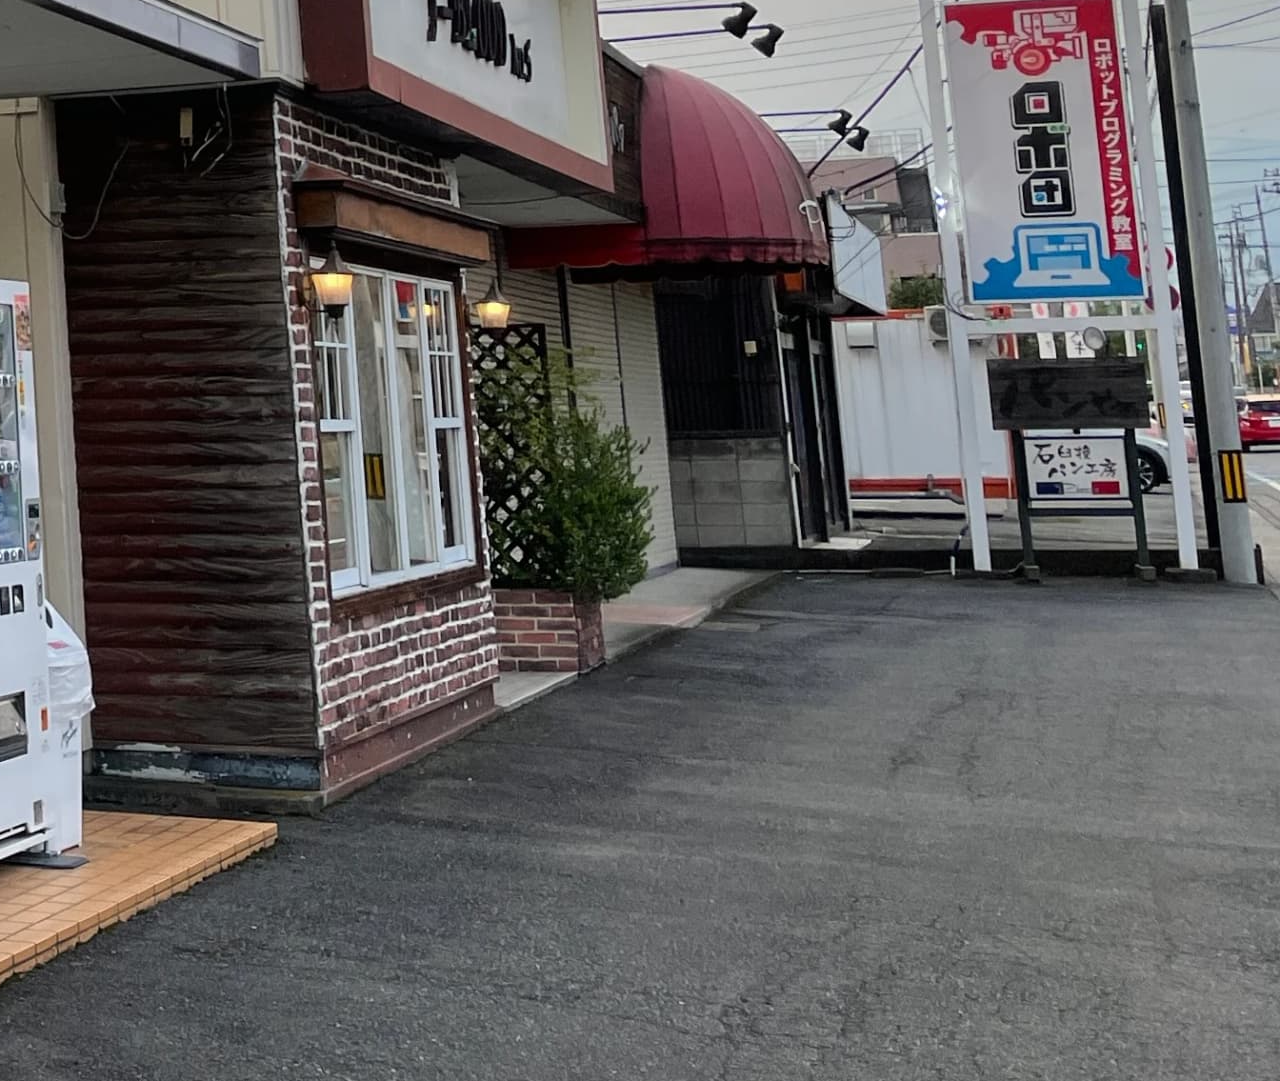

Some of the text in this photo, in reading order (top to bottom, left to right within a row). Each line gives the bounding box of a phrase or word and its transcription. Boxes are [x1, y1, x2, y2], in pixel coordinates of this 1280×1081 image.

[1093, 38, 1134, 251] ロボットプログラミング教室
